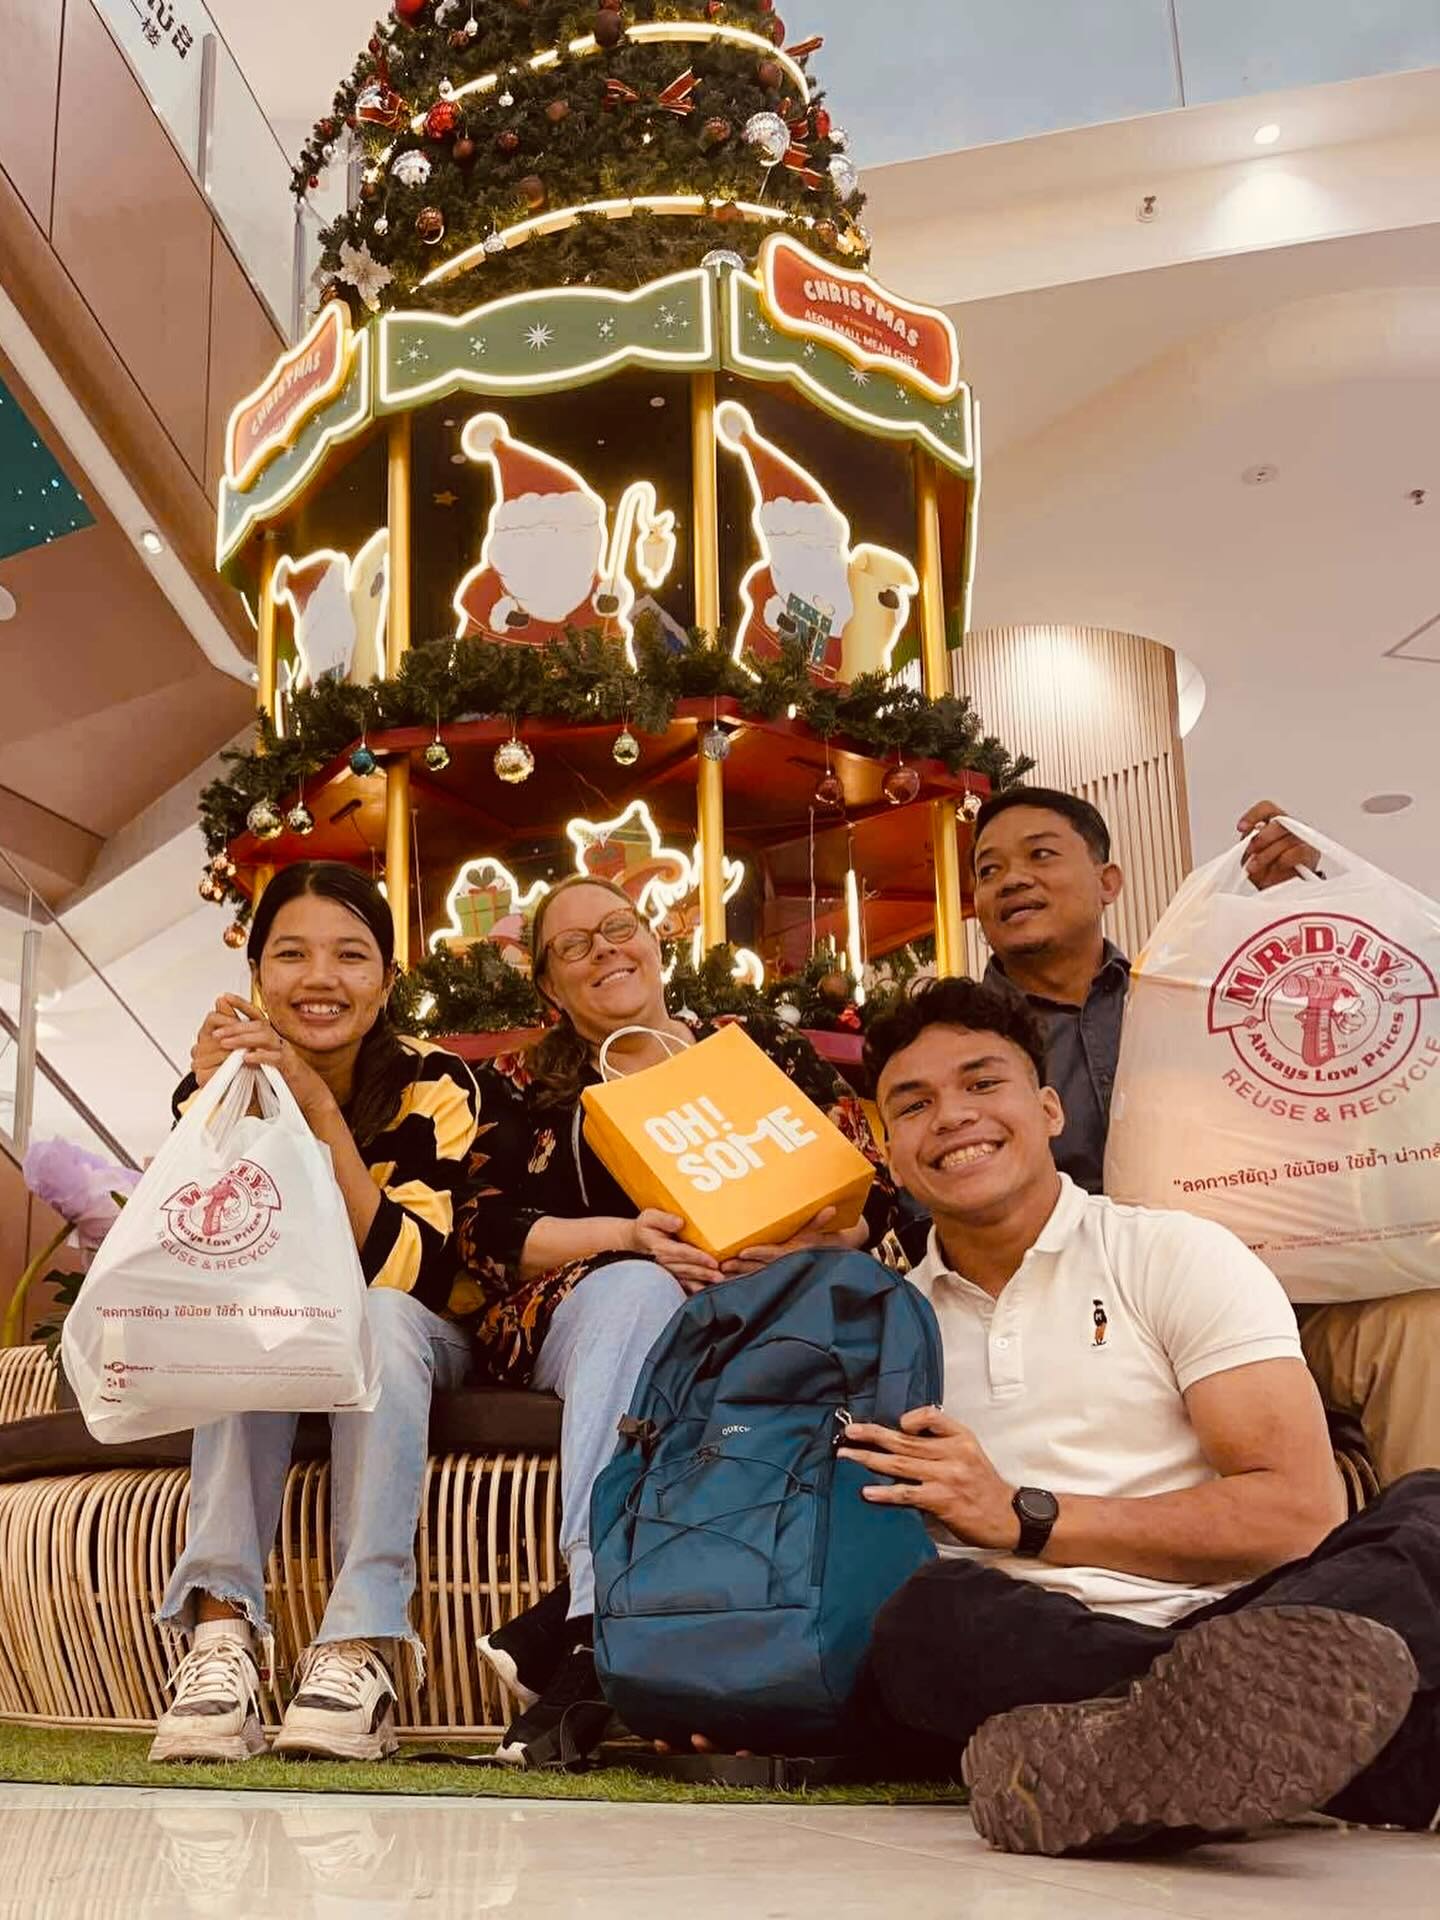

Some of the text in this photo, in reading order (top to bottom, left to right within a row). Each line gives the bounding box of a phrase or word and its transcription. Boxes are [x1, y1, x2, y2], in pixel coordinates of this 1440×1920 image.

[803, 279, 919, 347] CHRISTMAS
[804, 308, 834, 327] AEON
[1222, 1036, 1440, 1122] REUSE & RECYCLE
[1249, 1012, 1404, 1082] Always Low Prices
[644, 1095, 734, 1154] OH!
[676, 1105, 819, 1192] SOME
[215, 1230, 281, 1271] RECYCLE
